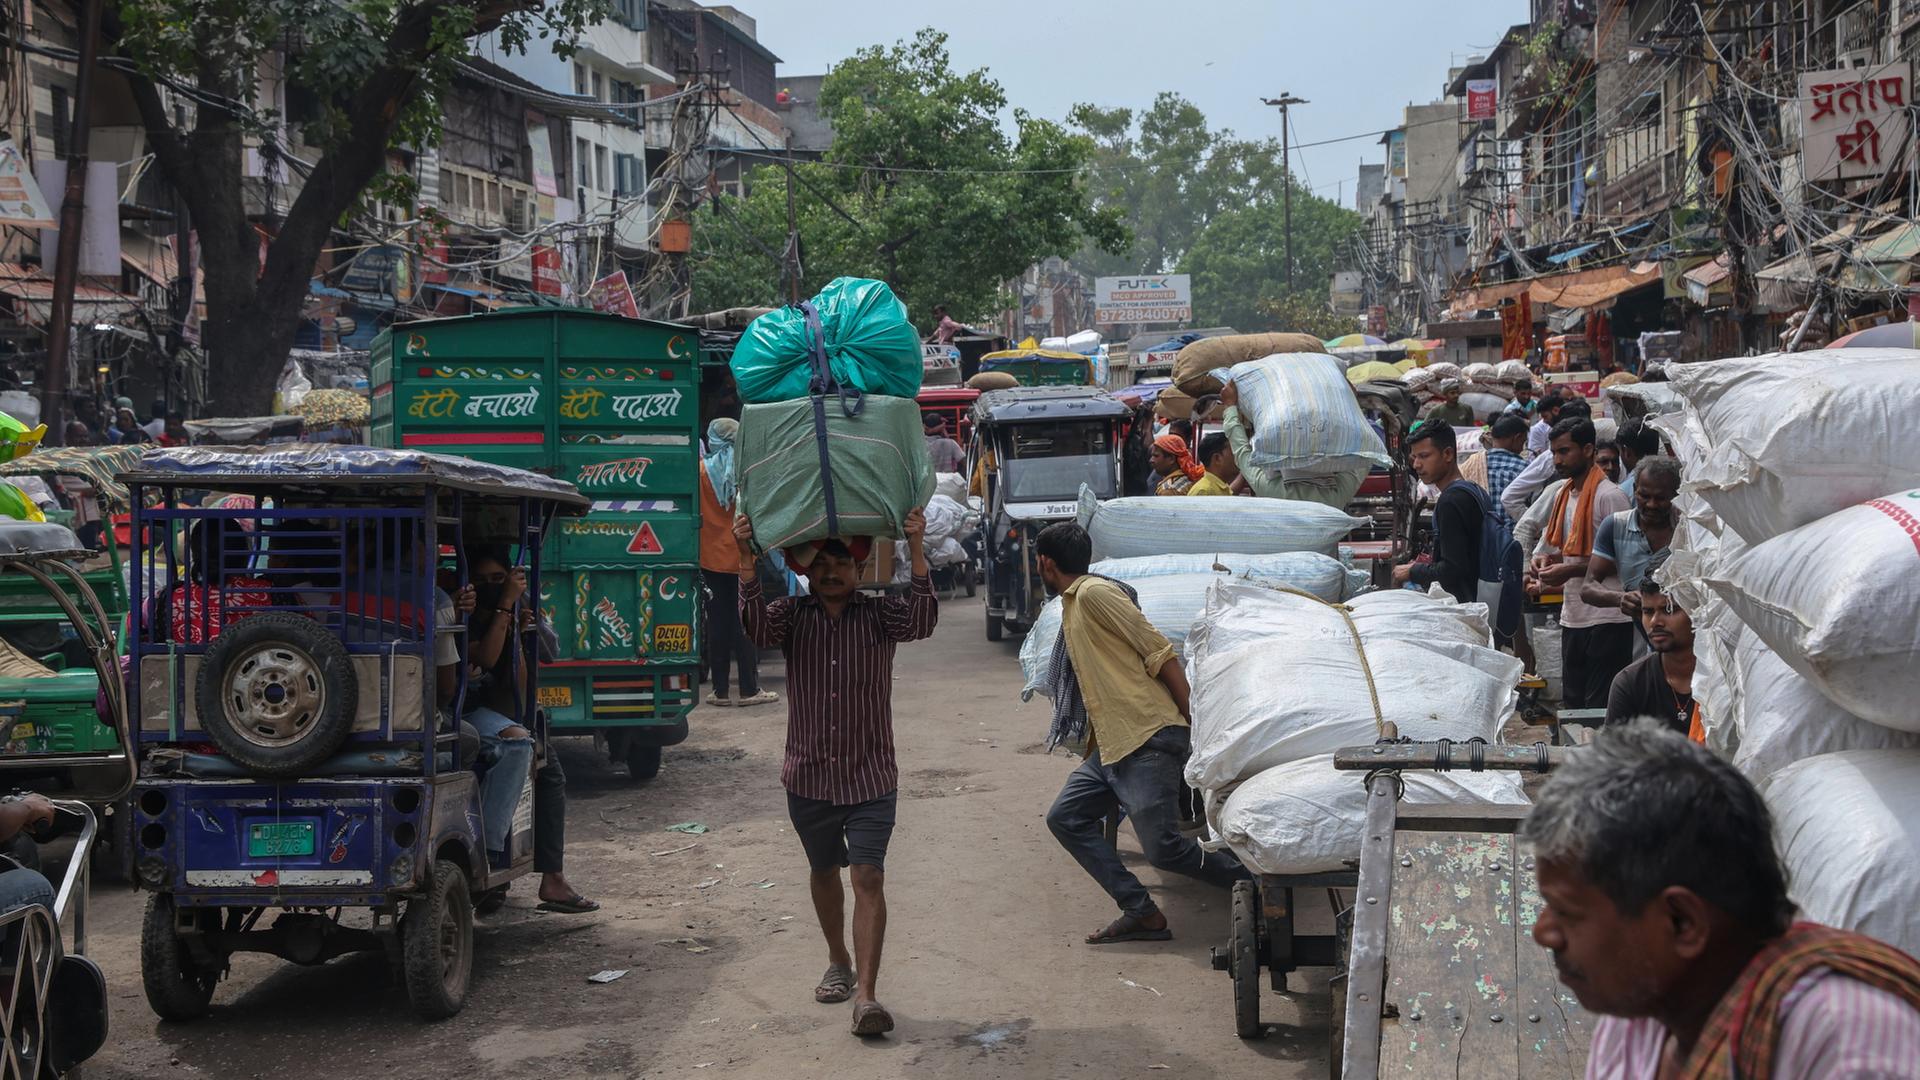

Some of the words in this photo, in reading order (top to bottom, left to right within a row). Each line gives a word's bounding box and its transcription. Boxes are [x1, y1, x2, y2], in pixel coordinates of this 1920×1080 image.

[1810, 77, 1905, 122] प्रताप
[1118, 278, 1168, 289] FUTEK
[1133, 291, 1175, 299] APPROVED
[1100, 308, 1187, 321] 9728840070
[408, 387, 461, 418] बेटी
[464, 385, 540, 418] बचाओ
[560, 387, 606, 419] बेटी
[612, 388, 682, 421] पढ़ाओ
[1047, 504, 1076, 513] Yatri
